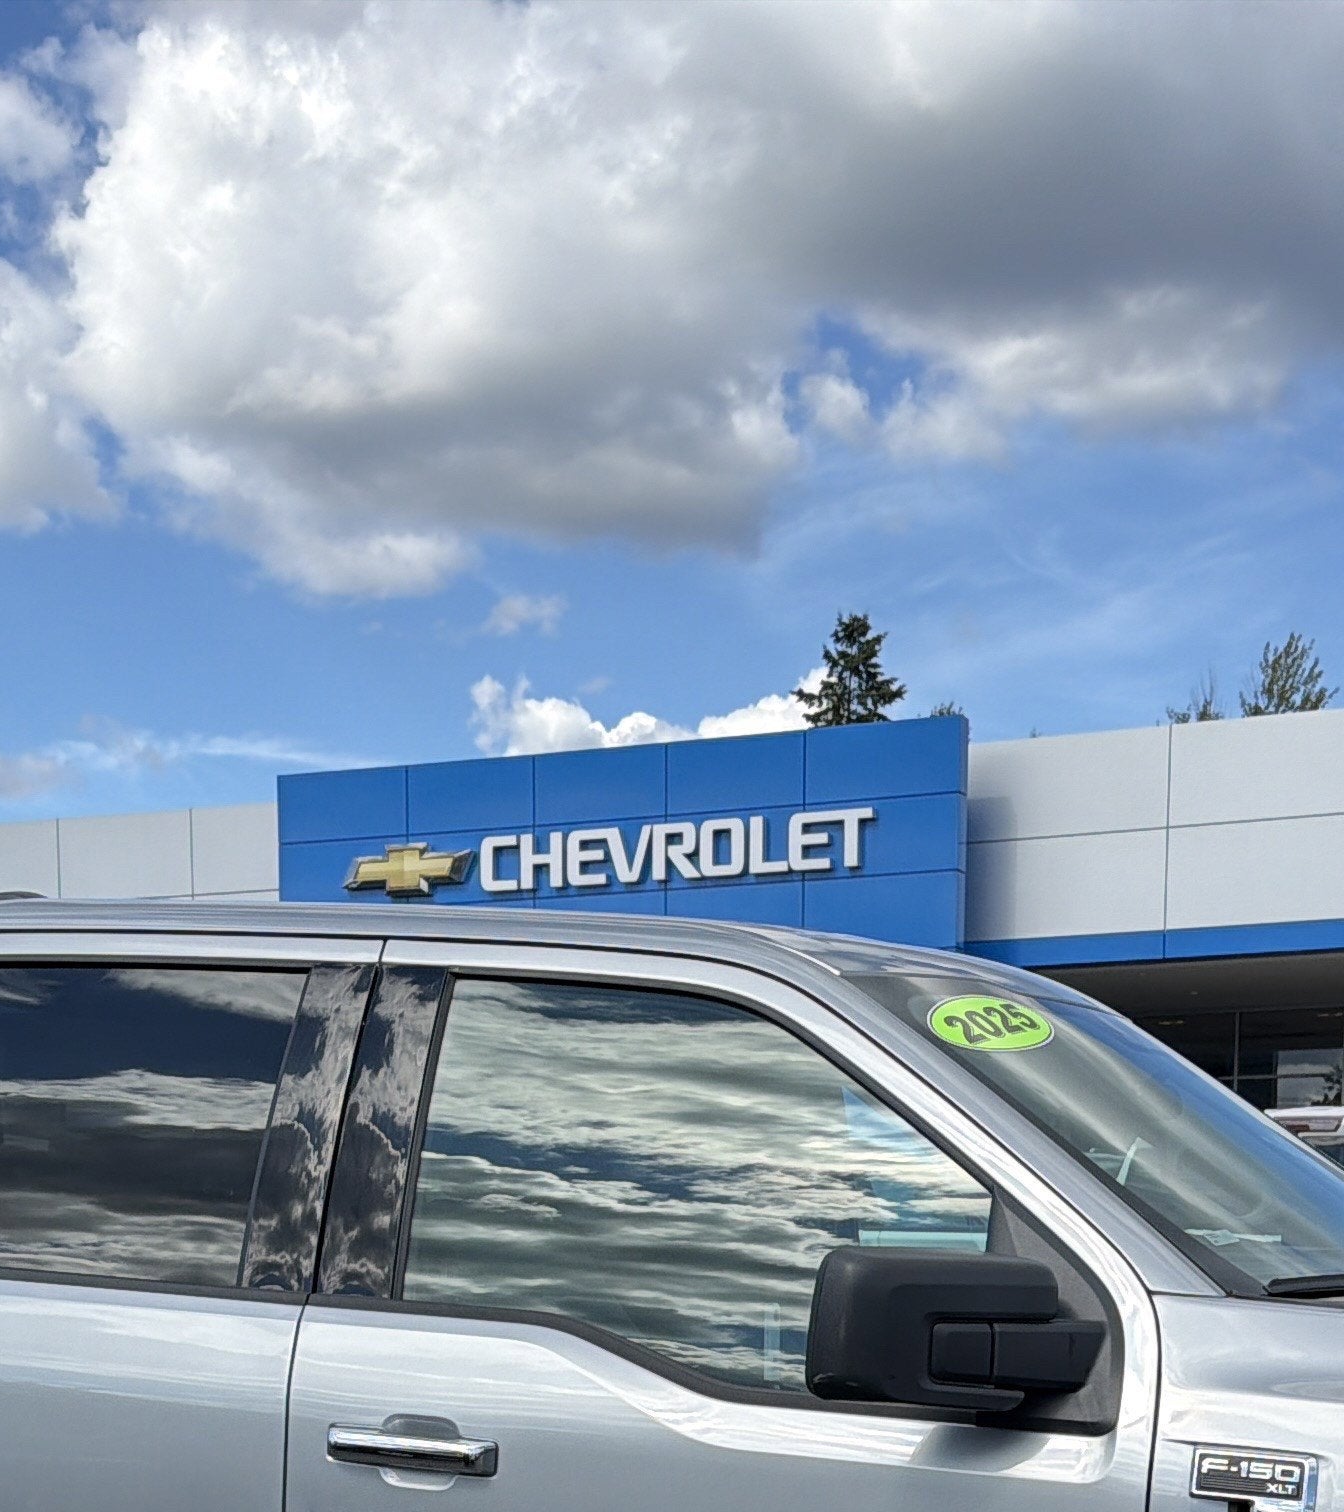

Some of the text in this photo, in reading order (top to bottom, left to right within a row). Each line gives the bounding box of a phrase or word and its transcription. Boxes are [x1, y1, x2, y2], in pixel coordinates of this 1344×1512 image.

[479, 806, 876, 893] CHEVROLET
[943, 1003, 1041, 1045] 2025
[1200, 1457, 1301, 1482] F-150
[1266, 1482, 1297, 1495] XLT
